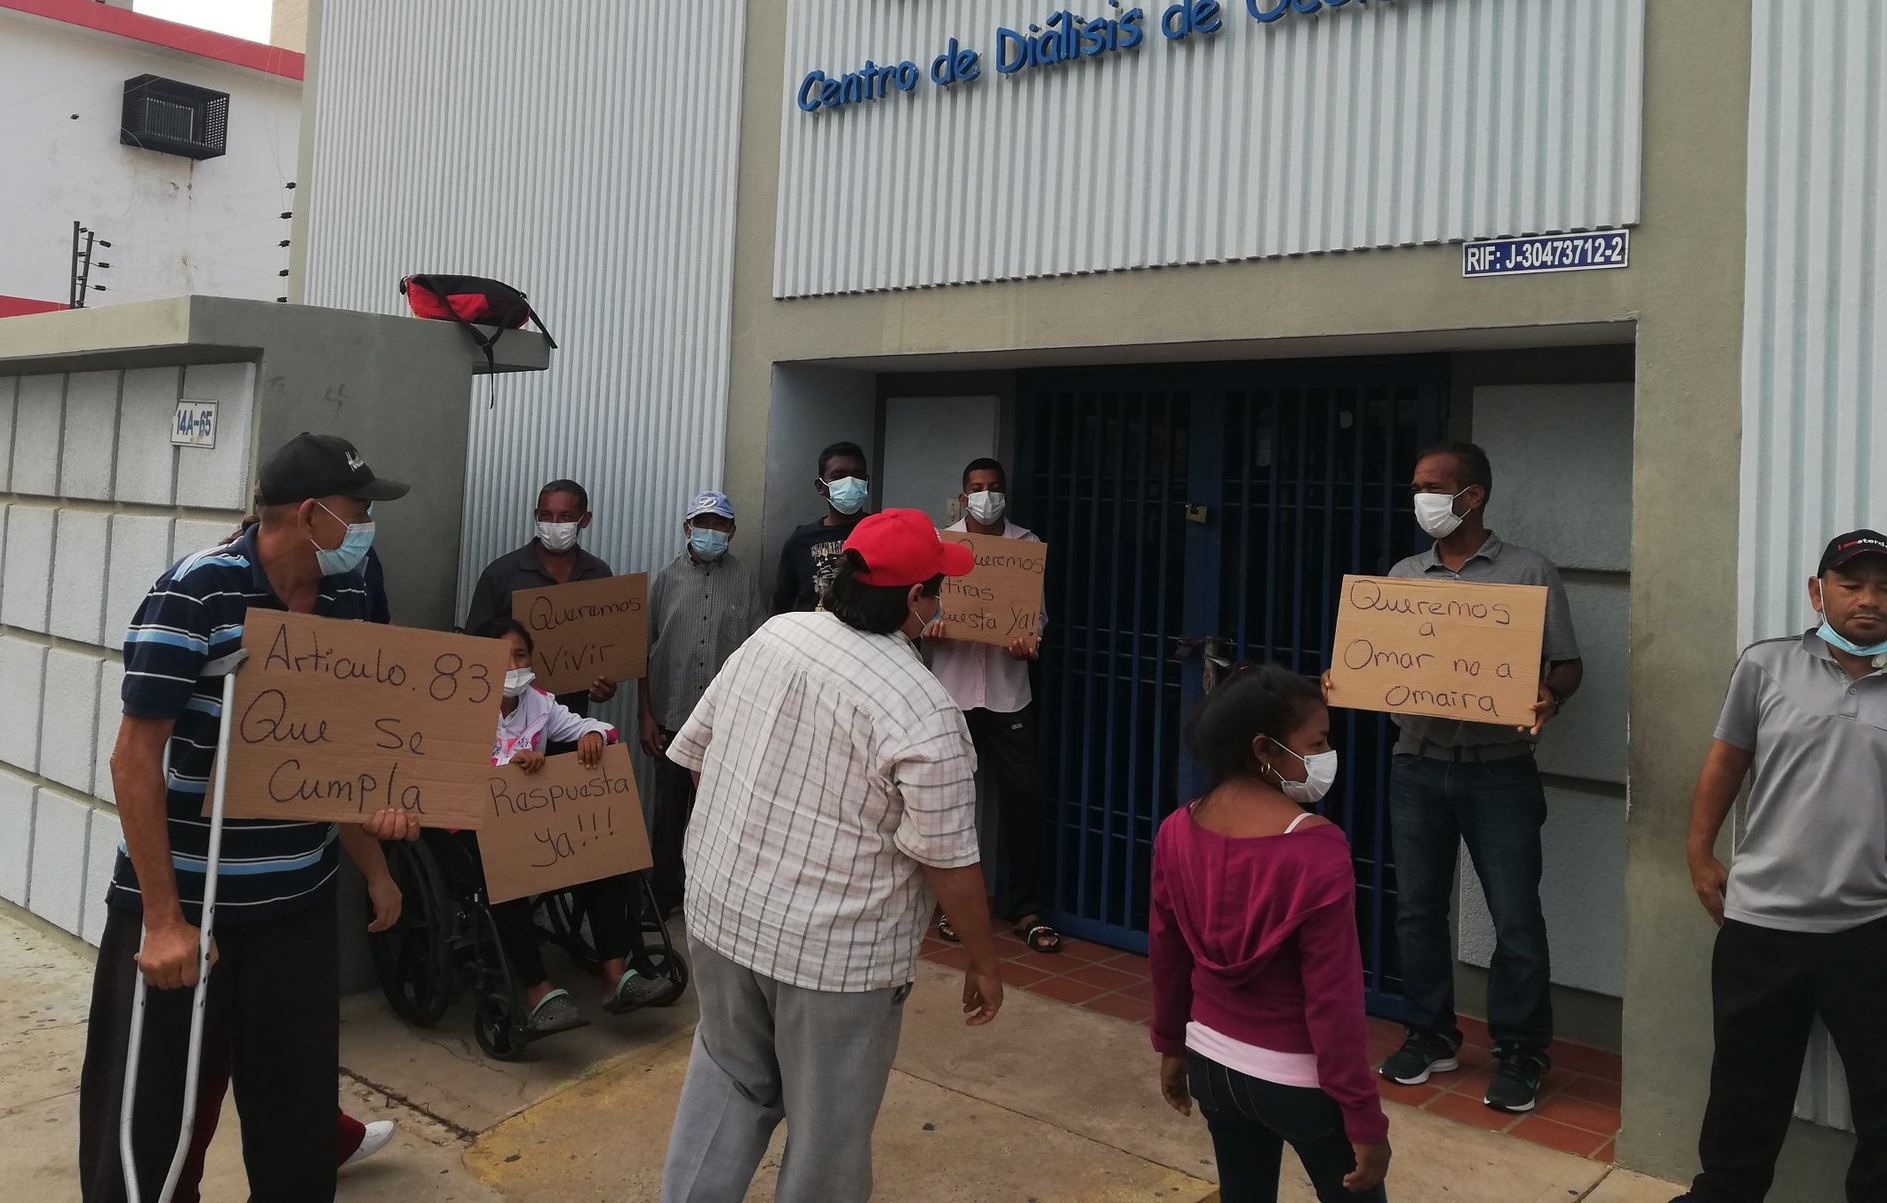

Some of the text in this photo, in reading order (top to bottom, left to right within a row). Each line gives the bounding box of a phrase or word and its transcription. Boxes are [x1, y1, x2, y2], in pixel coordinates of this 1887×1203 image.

[798, 60, 920, 112] Centro
[930, 37, 981, 86] de
[996, 0, 1144, 74] Diálisis
[1161, 0, 1223, 40] de
[1467, 237, 1623, 271] RIF: J-30473712-2
[176, 409, 213, 437] 14A-65
[940, 575, 994, 602] tiras
[1350, 579, 1511, 625] Queremos
[529, 595, 641, 631] Queremos
[1005, 606, 1036, 637] Ya!
[1418, 621, 1436, 638] a
[429, 653, 491, 704] 83
[1343, 638, 1513, 679] Omar no a
[239, 688, 331, 744] Que
[267, 758, 426, 815] Cumpla
[488, 765, 630, 818] Respuesta
